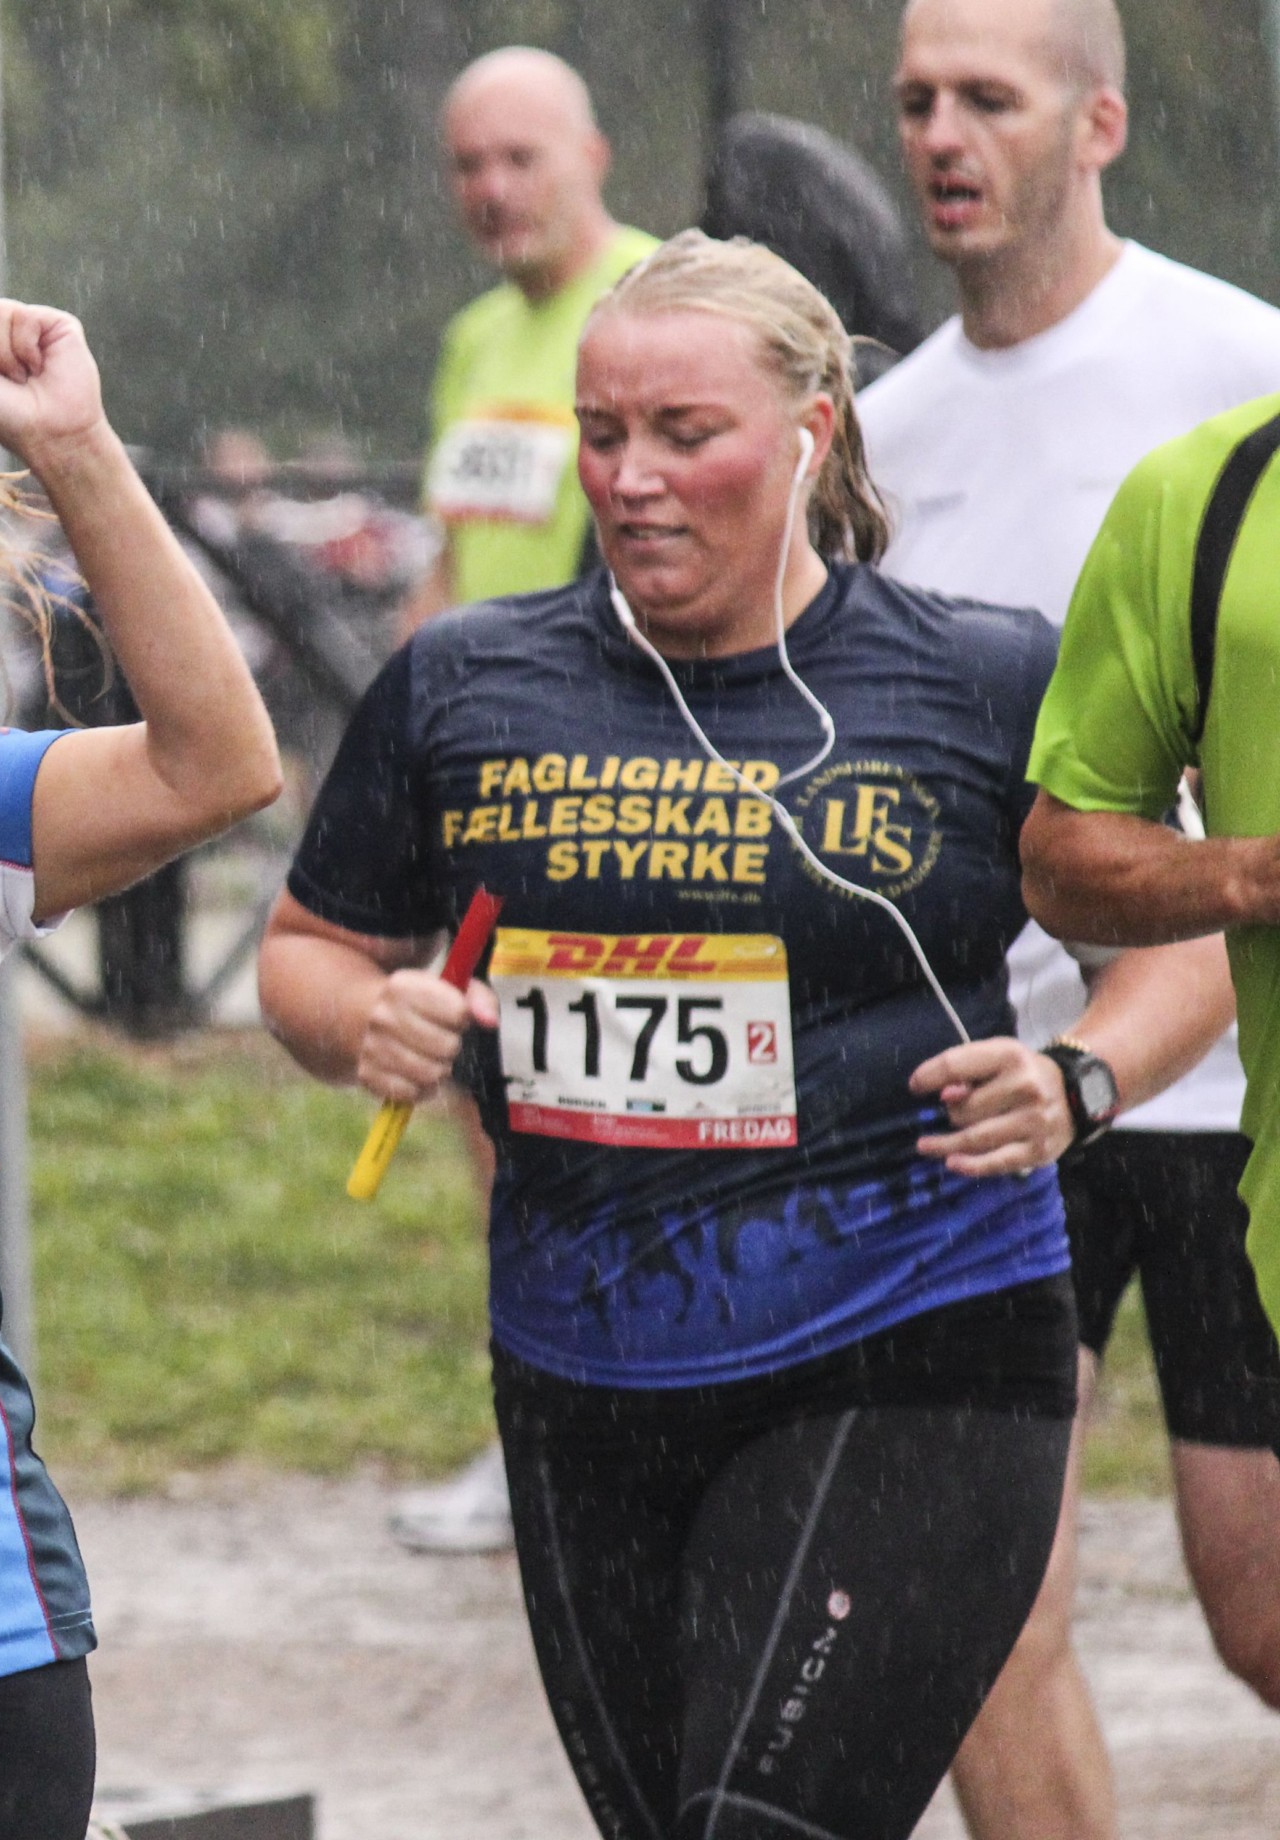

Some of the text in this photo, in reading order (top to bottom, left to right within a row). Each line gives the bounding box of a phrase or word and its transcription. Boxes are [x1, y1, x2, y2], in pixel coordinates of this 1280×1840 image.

[480, 753, 780, 798] FAGLIGHED
[441, 795, 773, 848] FÆLLESSKAB
[546, 840, 770, 883] STYRKE
[546, 933, 717, 972] DHL
[516, 986, 730, 1085] 1175
[749, 1023, 775, 1063] 2
[698, 1118, 792, 1143] FREDAG
